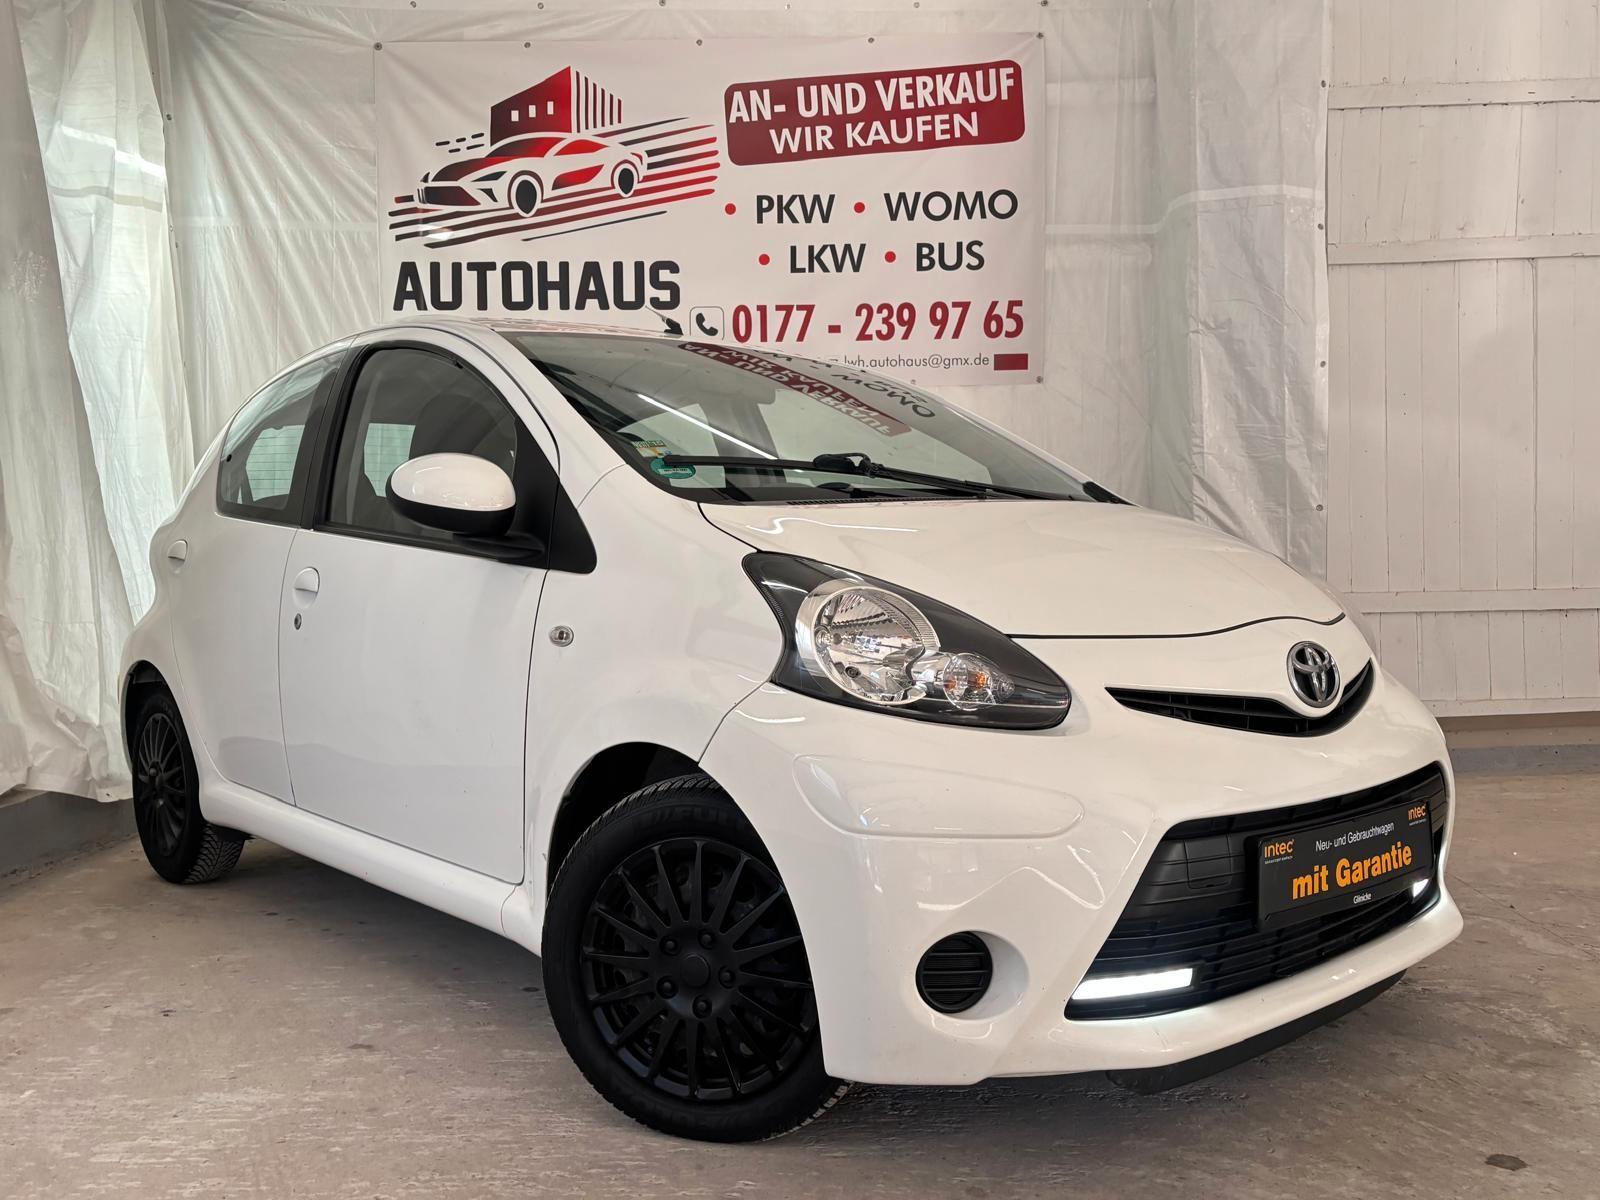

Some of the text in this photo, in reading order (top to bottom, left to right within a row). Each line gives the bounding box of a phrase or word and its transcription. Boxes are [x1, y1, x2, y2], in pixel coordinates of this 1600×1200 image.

[729, 67, 1015, 123] AN- UND VERKAUF
[769, 111, 979, 154] WIR KAUFEN
[756, 189, 1019, 224] PKW WOMO
[790, 240, 985, 273] LKW BUS
[393, 260, 681, 311] AUTOHAUS
[732, 304, 816, 343] 0177
[855, 302, 917, 341] 239
[929, 301, 971, 340] 97
[983, 300, 1024, 339] 65
[1315, 840, 1332, 851] Neu-
[1334, 835, 1346, 847] und
[1347, 822, 1395, 844] Gebrauchtwagen
[1292, 841, 1412, 899] mit Garantie
